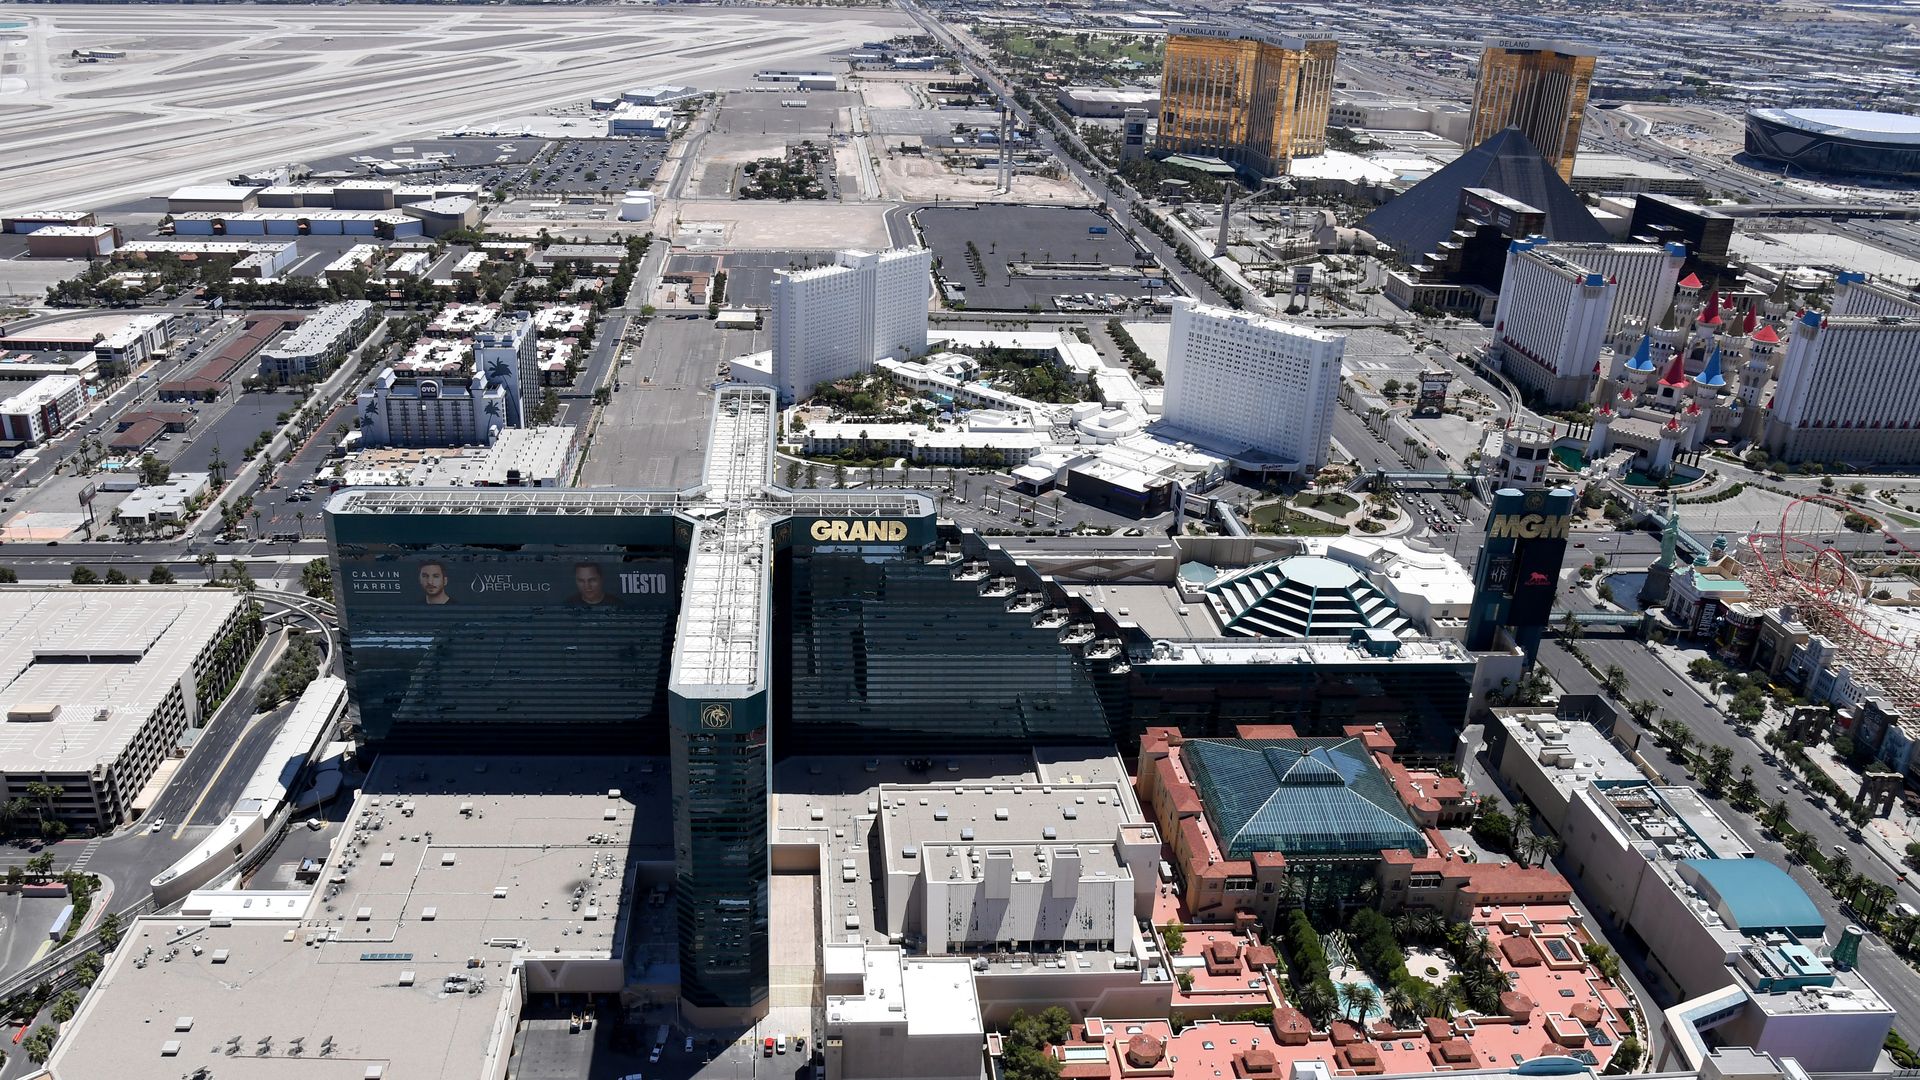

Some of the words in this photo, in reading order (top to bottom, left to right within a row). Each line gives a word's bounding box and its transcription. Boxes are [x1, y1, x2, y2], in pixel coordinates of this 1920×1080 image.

[1179, 27, 1216, 37] MANDALAY
[1499, 40, 1530, 48] DELANO
[810, 519, 908, 542] GRAND
[1489, 513, 1570, 539] MGM
[352, 570, 400, 578] CALVIN
[484, 574, 512, 583] WET
[353, 582, 401, 590] HARRIS
[485, 582, 551, 592] REPUBLIC
[619, 571, 667, 594] TIËSTO
